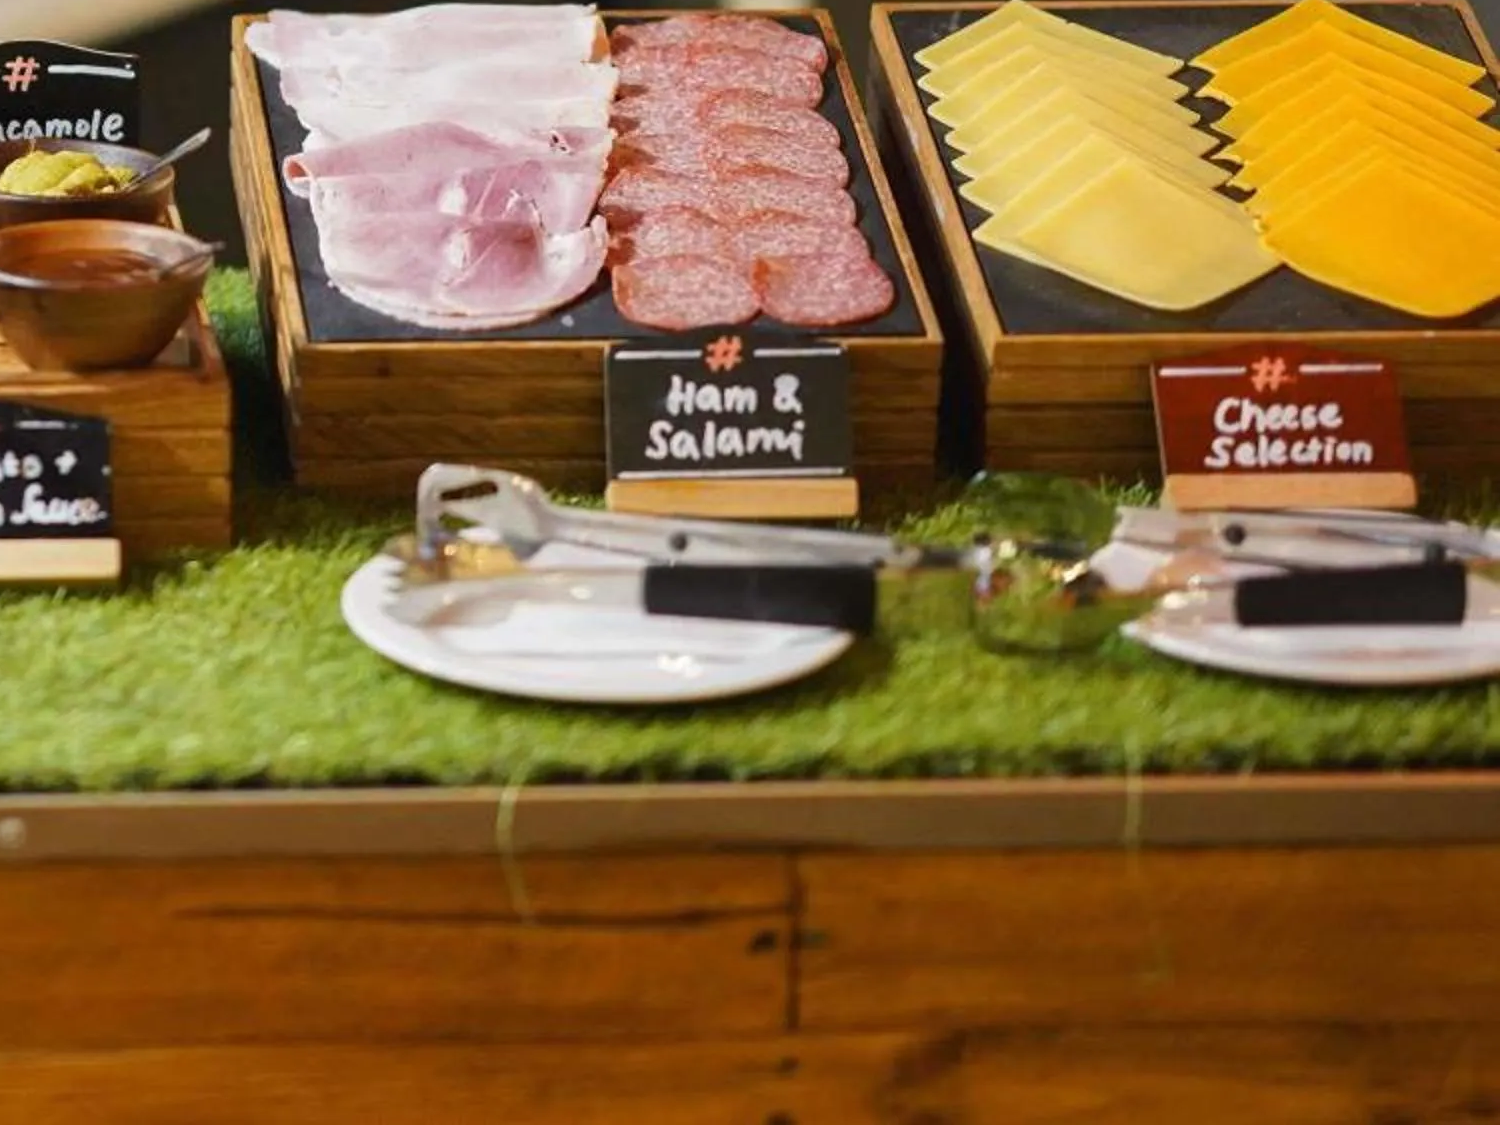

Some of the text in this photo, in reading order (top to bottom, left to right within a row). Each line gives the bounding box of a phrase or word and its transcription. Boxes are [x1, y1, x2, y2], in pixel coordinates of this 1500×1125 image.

[665, 373, 803, 416] Ham &
[1213, 396, 1344, 435] Cheese
[644, 419, 806, 462] Salami
[1204, 434, 1373, 469] Selection
